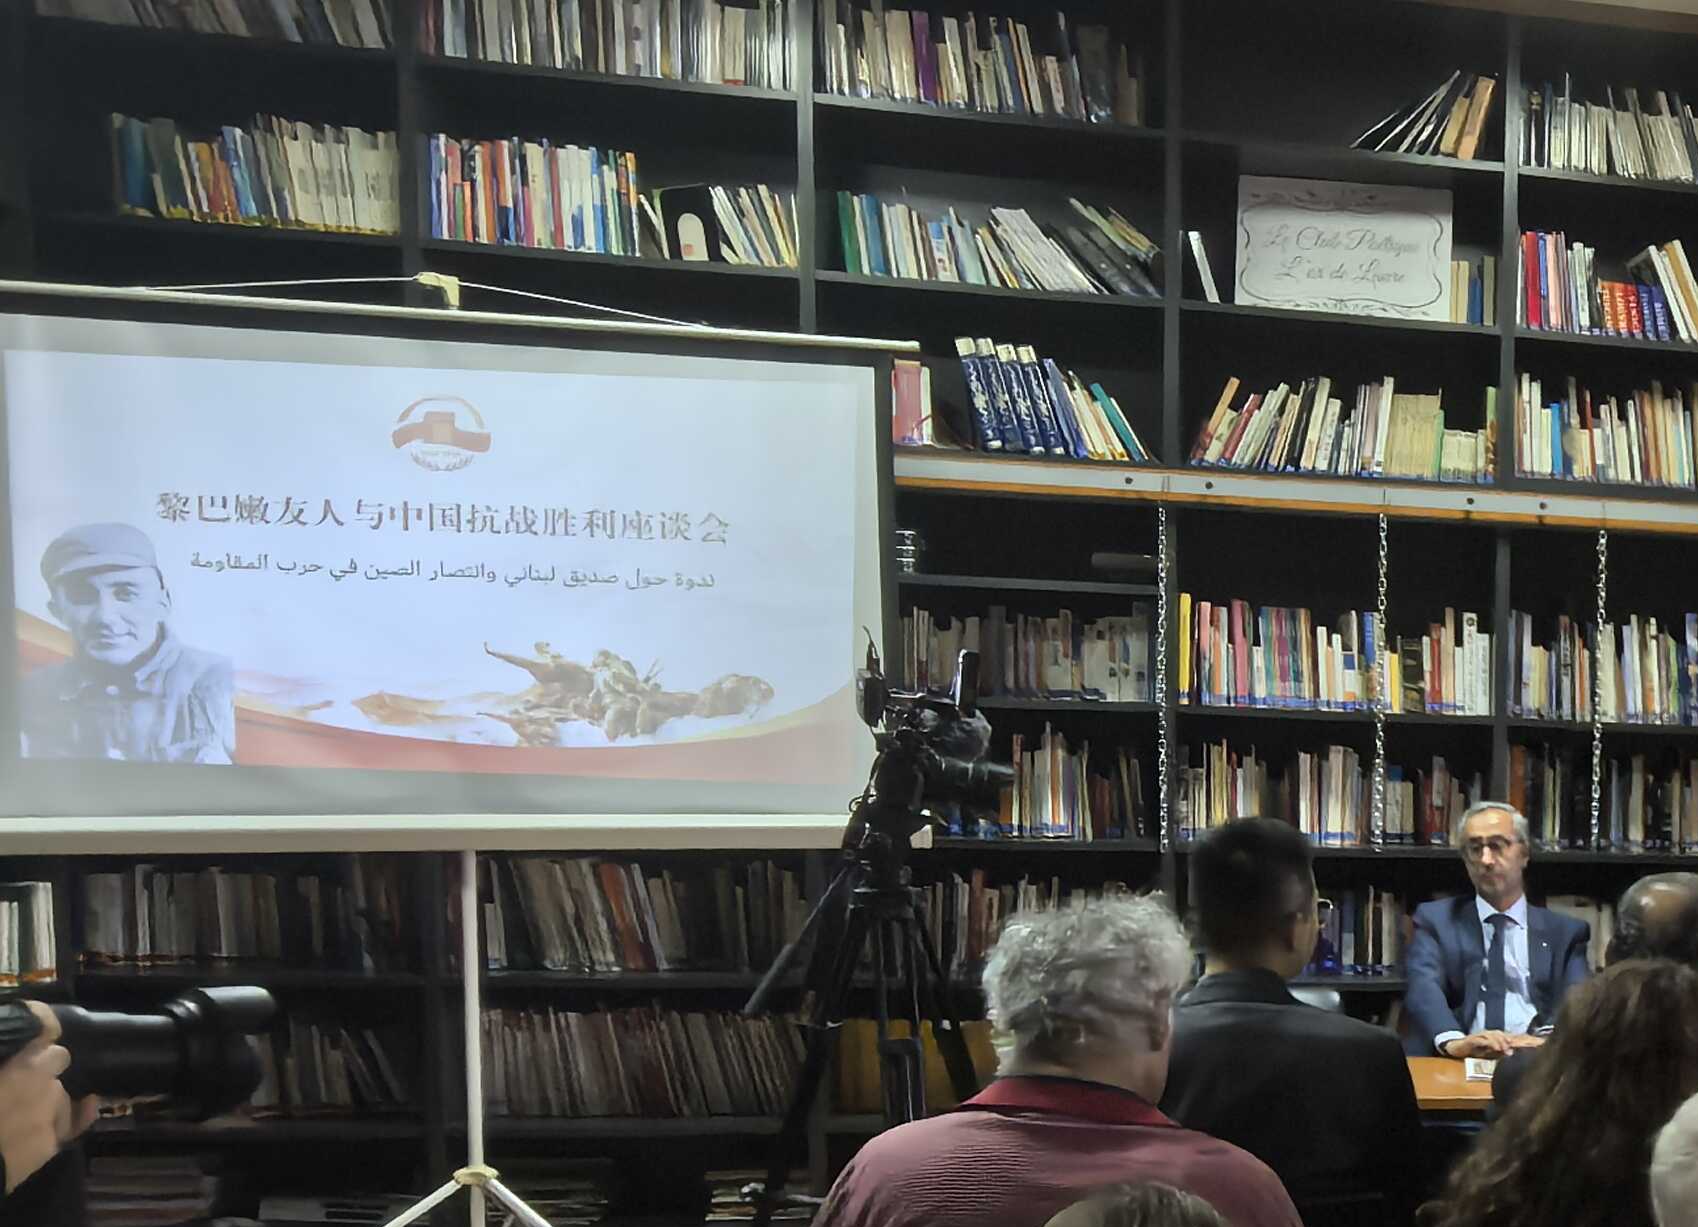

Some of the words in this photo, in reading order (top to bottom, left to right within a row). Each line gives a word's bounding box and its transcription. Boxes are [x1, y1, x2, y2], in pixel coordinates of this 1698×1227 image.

[157, 491, 730, 545] 黎巴嫩友人与中国抗战胜利座谈会
[190, 551, 269, 573] المقاومة
[276, 560, 323, 576] حرب
[329, 558, 357, 582] في
[364, 559, 420, 580] الصين
[503, 564, 556, 588] لبناني
[562, 569, 618, 588] صديق
[624, 567, 668, 590] حول
